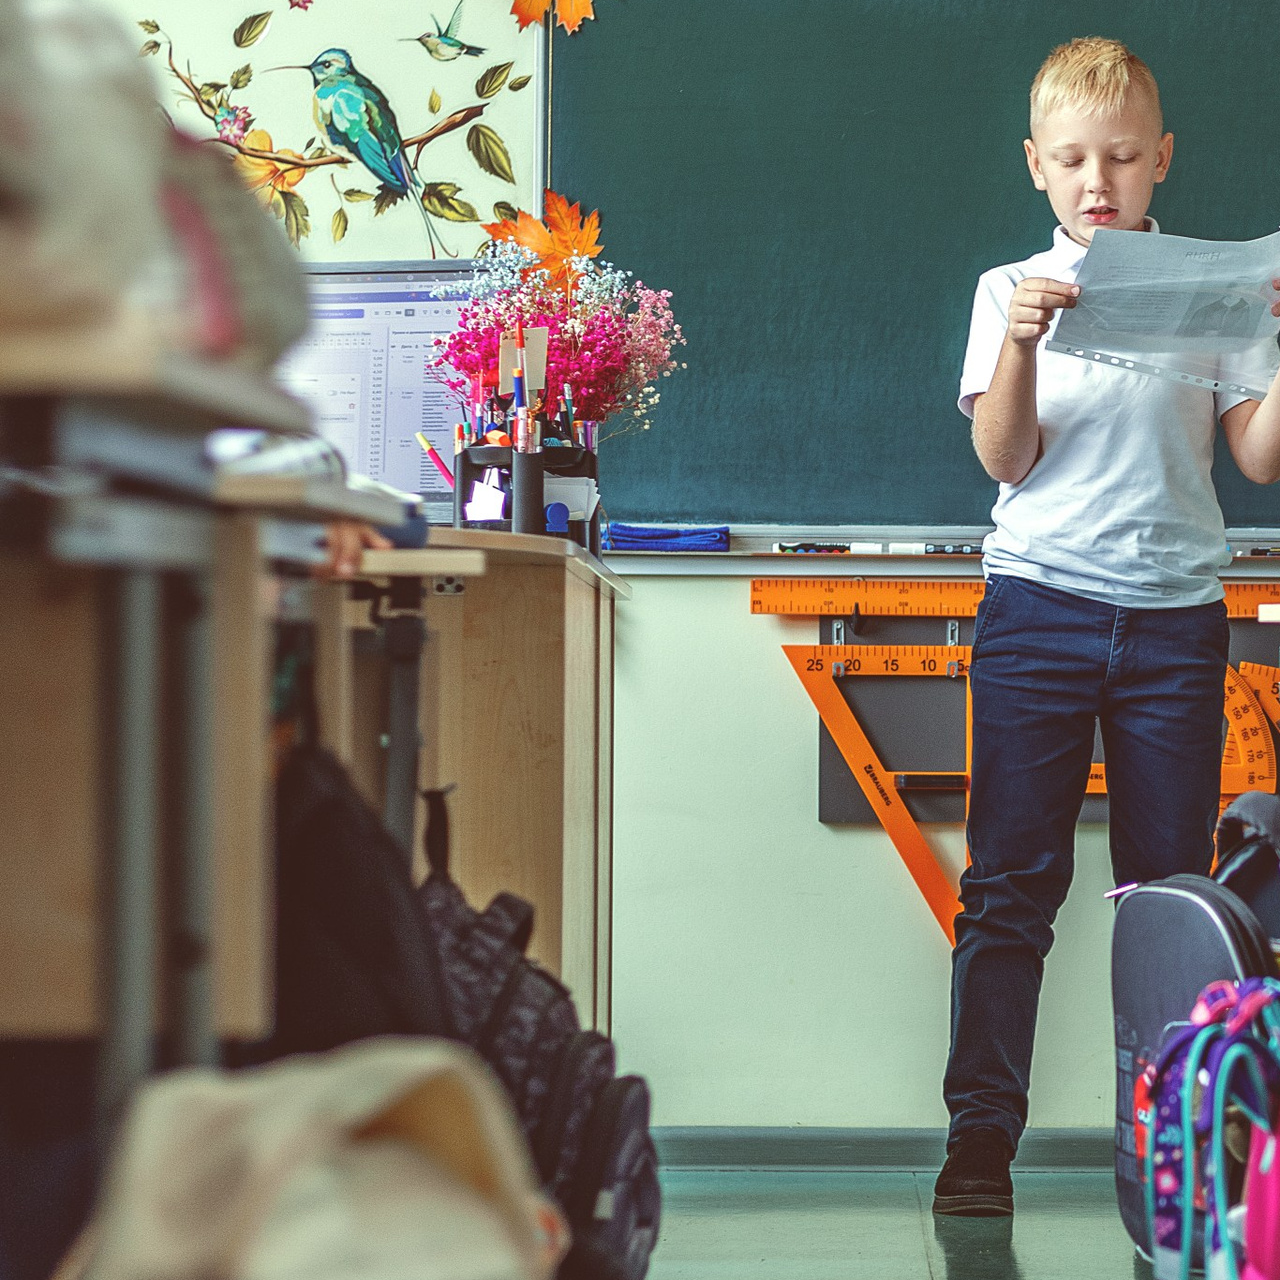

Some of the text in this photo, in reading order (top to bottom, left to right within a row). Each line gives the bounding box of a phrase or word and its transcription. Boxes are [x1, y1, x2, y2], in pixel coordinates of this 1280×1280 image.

[806, 659, 937, 672] 25 20 15 10
[868, 771, 892, 806] BRAUBERG
